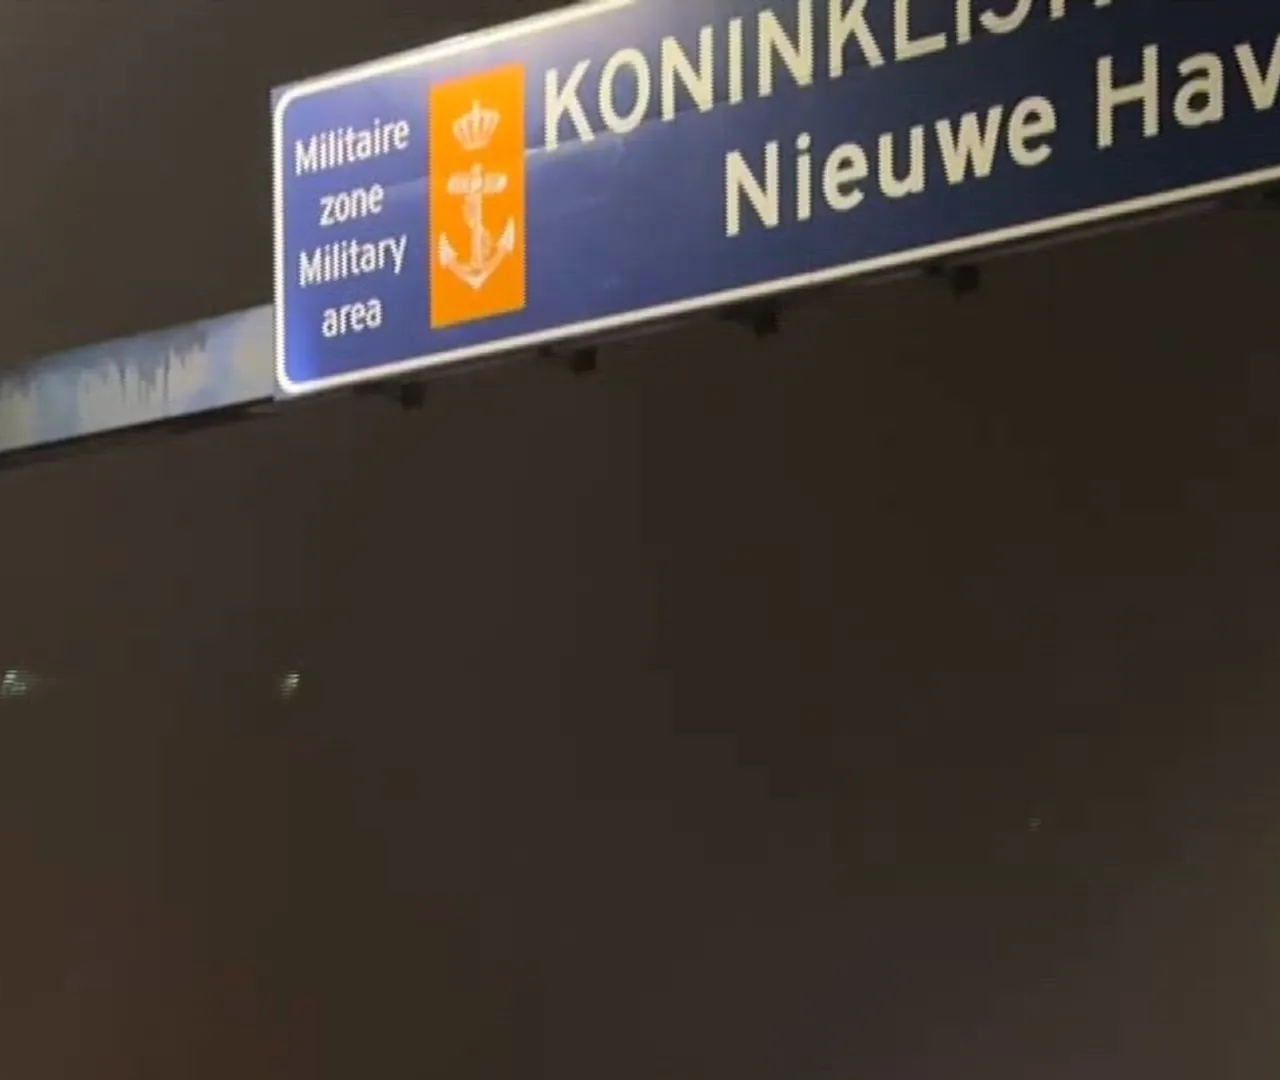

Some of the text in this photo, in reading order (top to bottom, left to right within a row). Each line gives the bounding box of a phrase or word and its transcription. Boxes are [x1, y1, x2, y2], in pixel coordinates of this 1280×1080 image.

[545, 0, 1113, 152] KONINKLIJ
[295, 117, 410, 177] Militaire
[725, 95, 1056, 238] Nieuwe
[319, 183, 384, 227] zone
[298, 233, 408, 288] Military
[322, 297, 382, 339] area
